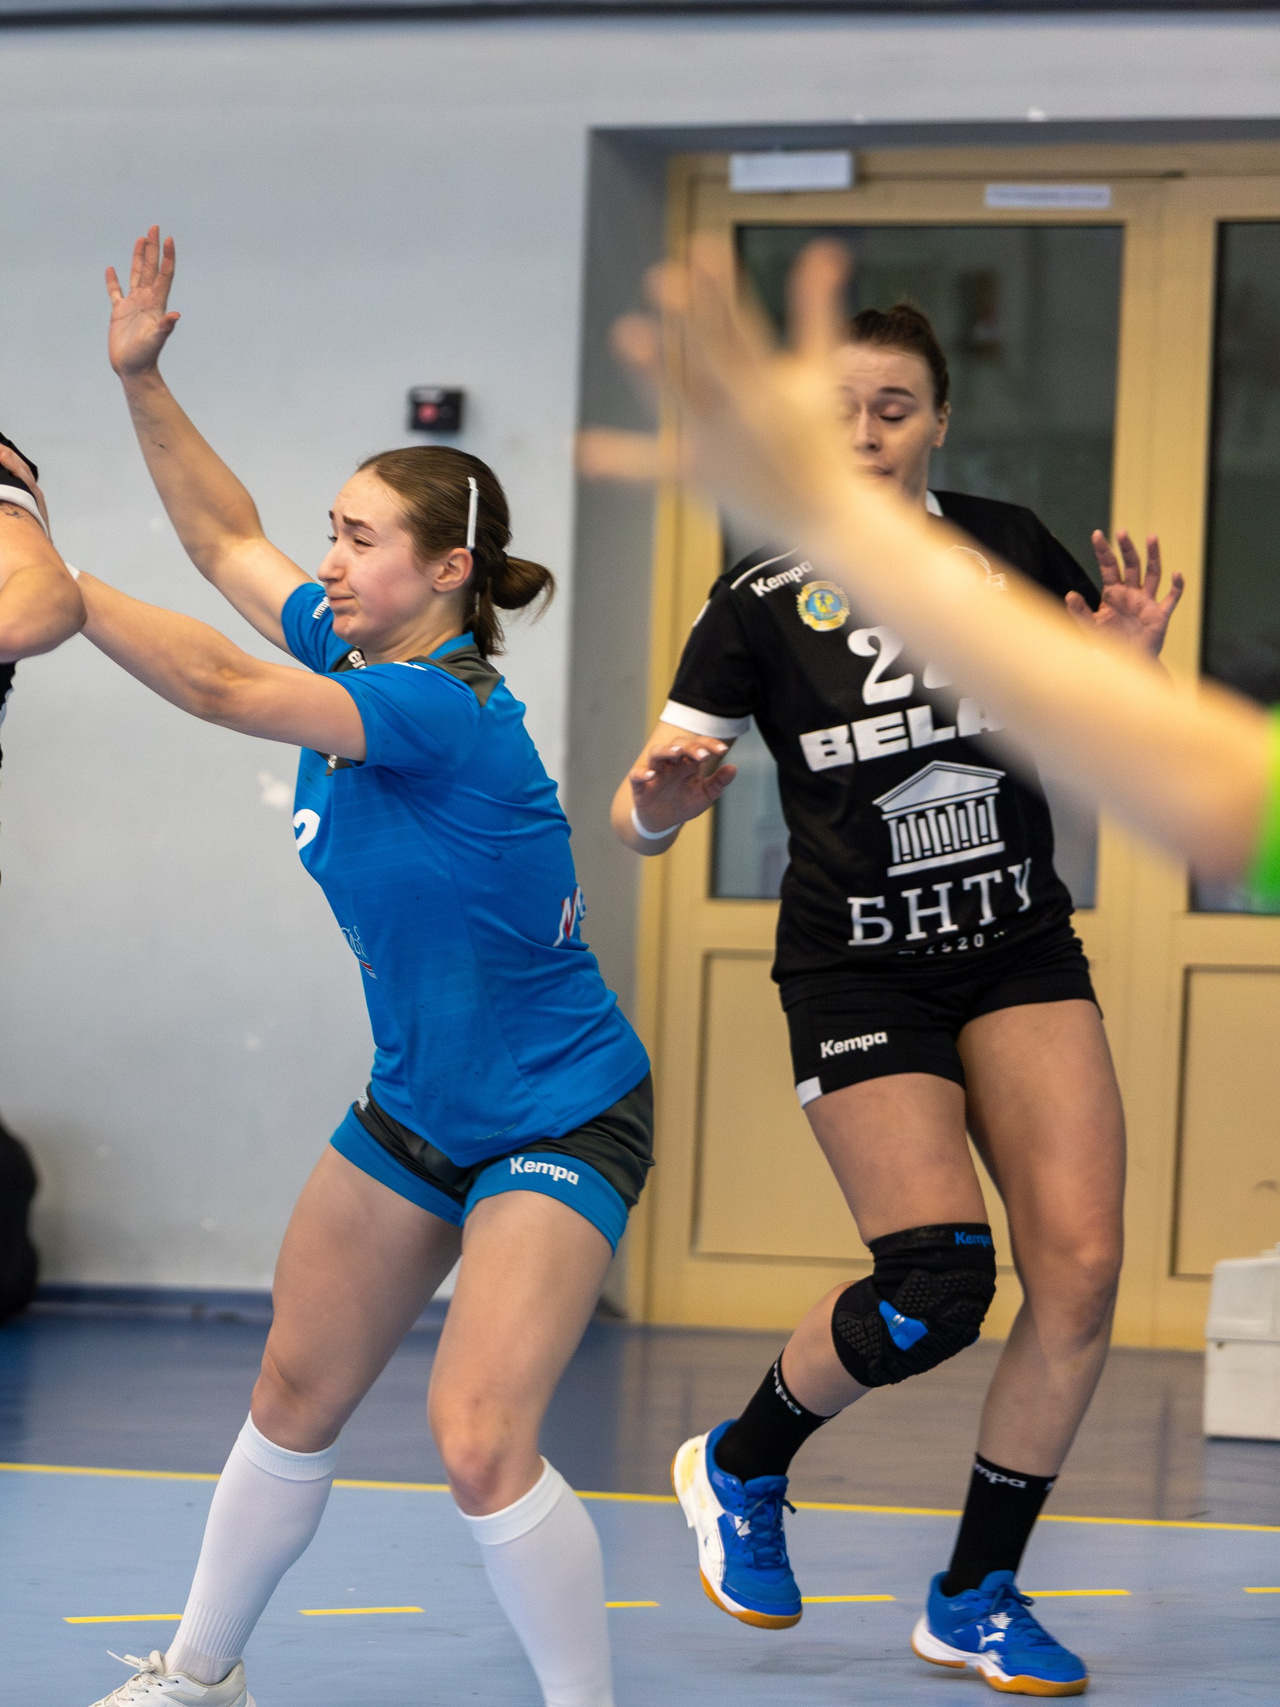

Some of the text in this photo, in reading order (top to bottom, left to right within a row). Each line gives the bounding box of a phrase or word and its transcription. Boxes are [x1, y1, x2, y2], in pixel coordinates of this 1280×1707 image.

[749, 560, 814, 597] Kempa
[847, 625, 954, 705] 2
[799, 697, 1005, 772] BELA
[847, 857, 1032, 946] БНТУ
[820, 1031, 888, 1059] Kempa
[510, 1156, 579, 1185] Kempa
